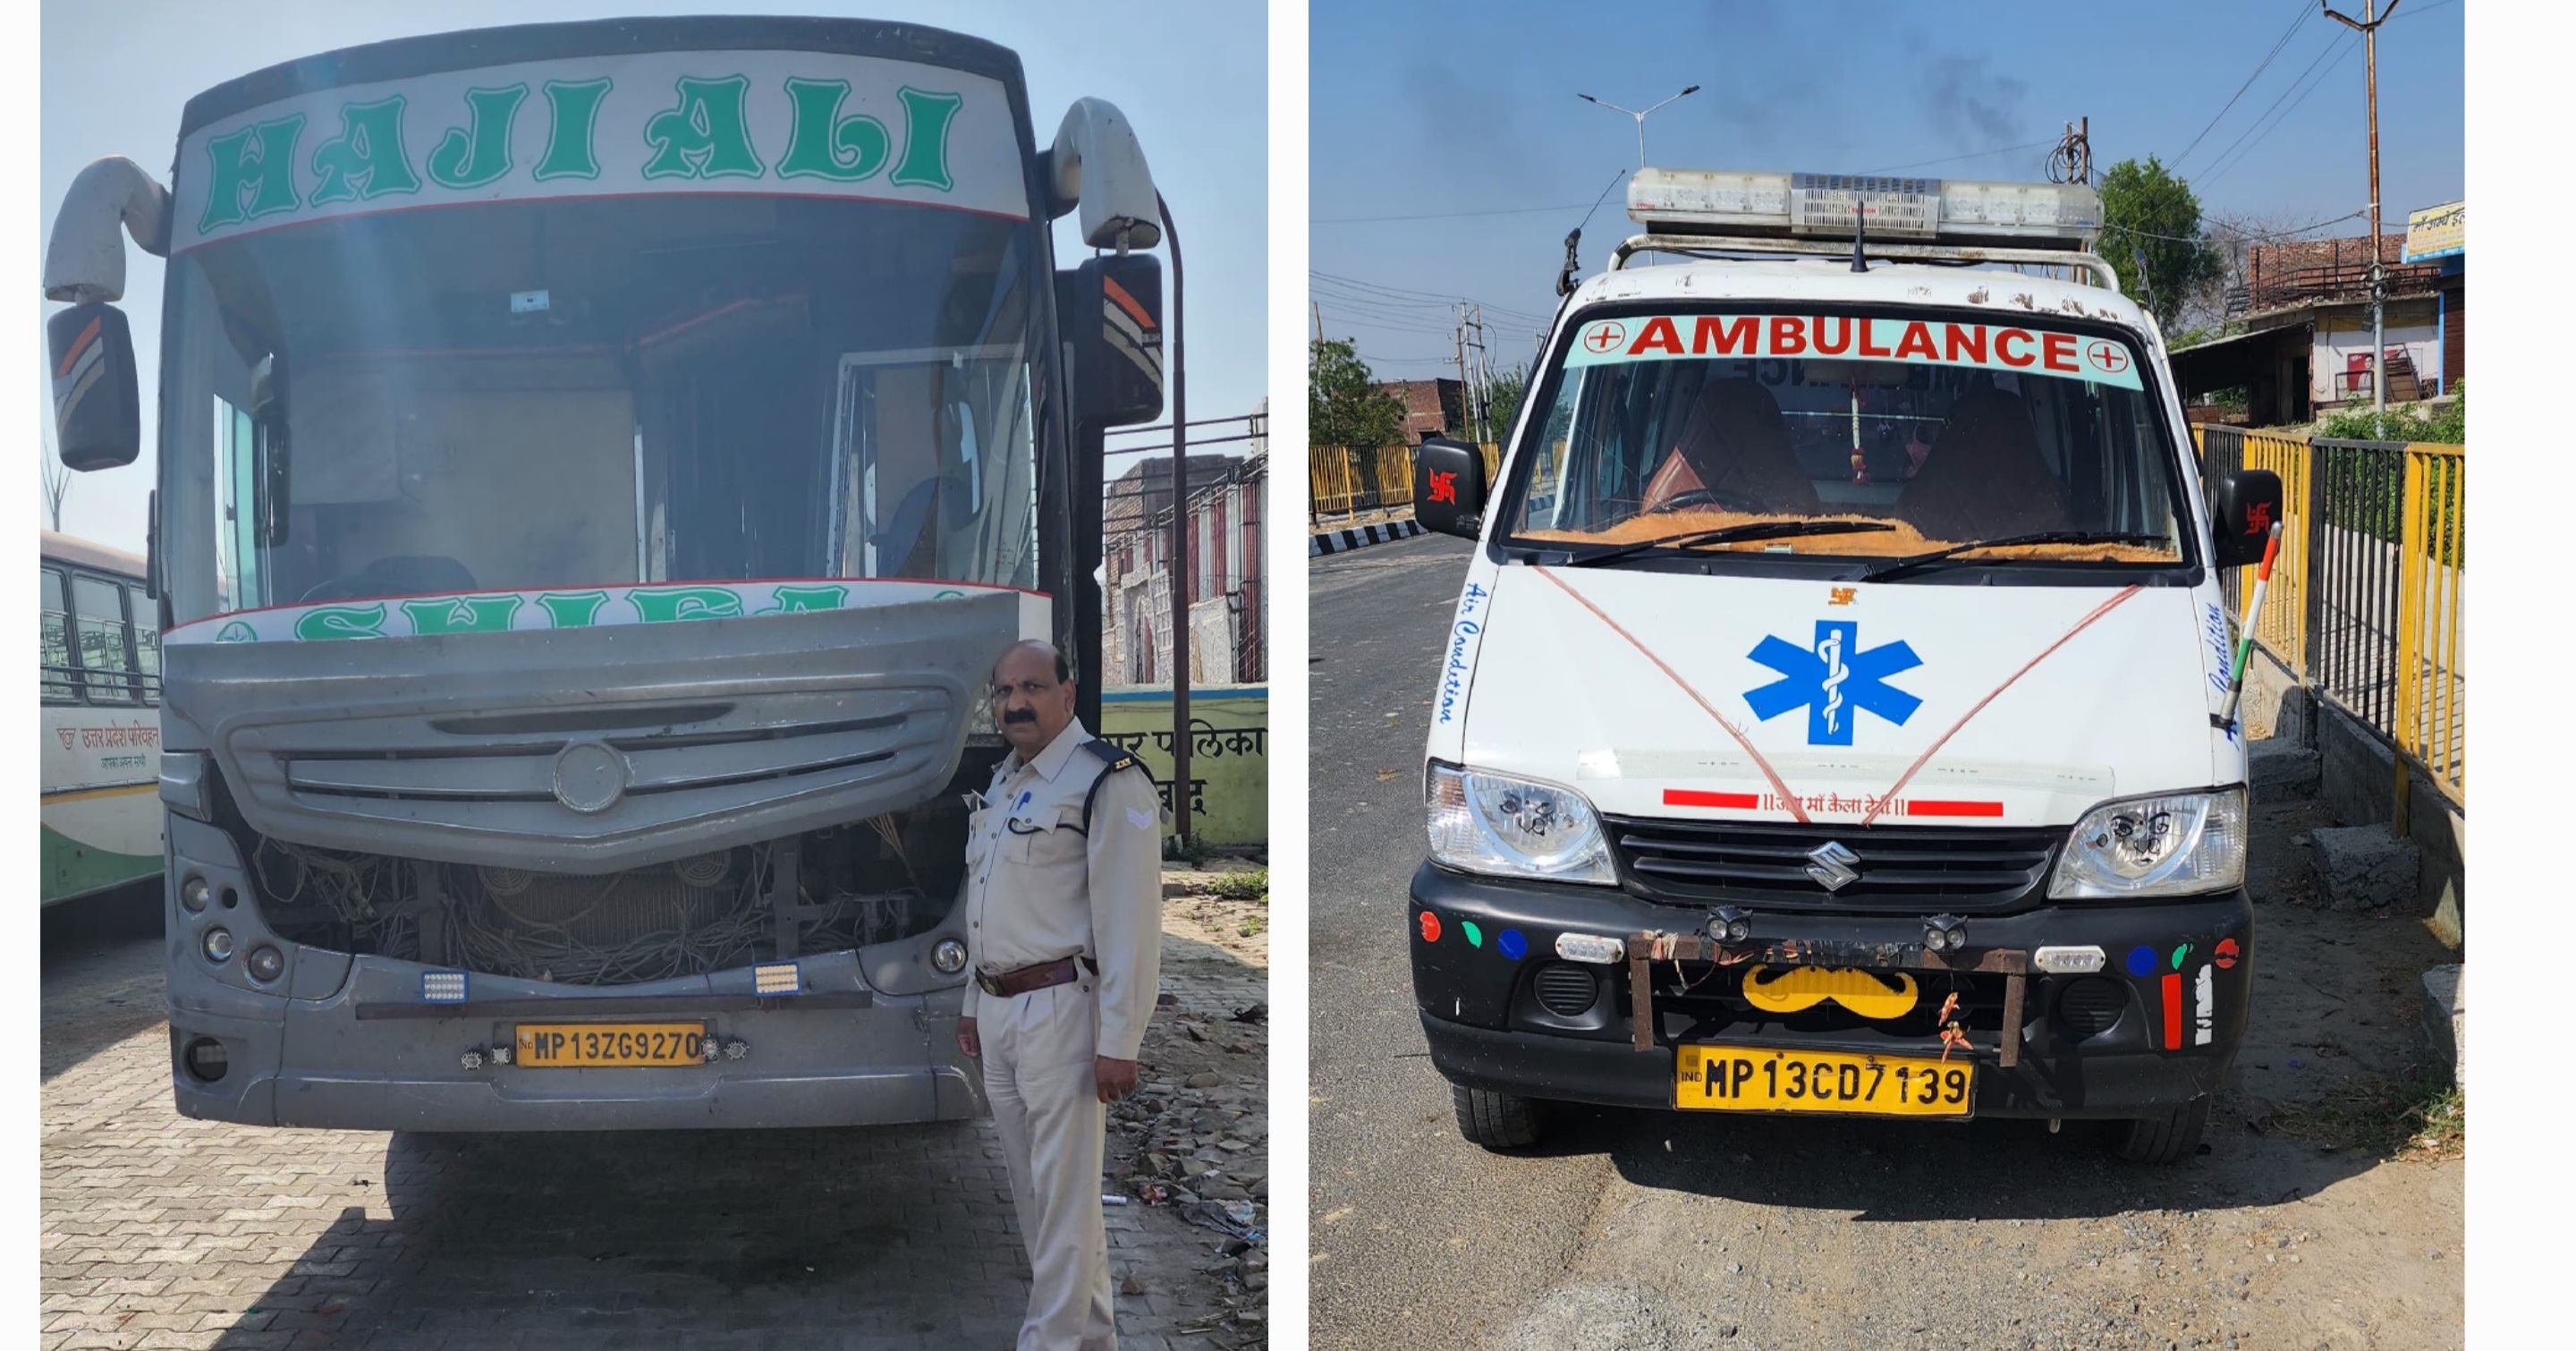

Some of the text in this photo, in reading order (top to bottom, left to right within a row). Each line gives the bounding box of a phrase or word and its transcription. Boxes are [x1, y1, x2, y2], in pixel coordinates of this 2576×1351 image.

[198, 73, 963, 235] HAJI ALI
[1626, 315, 2082, 373] AMBULANCE
[1461, 582, 1487, 615] Air
[127, 718, 160, 748] परिवहन
[1152, 718, 1268, 759] पलिका
[1827, 791, 1862, 813] कैला
[535, 1032, 700, 1059] MP13ZG9270
[1681, 1058, 1967, 1105] IND MP13CD7139
